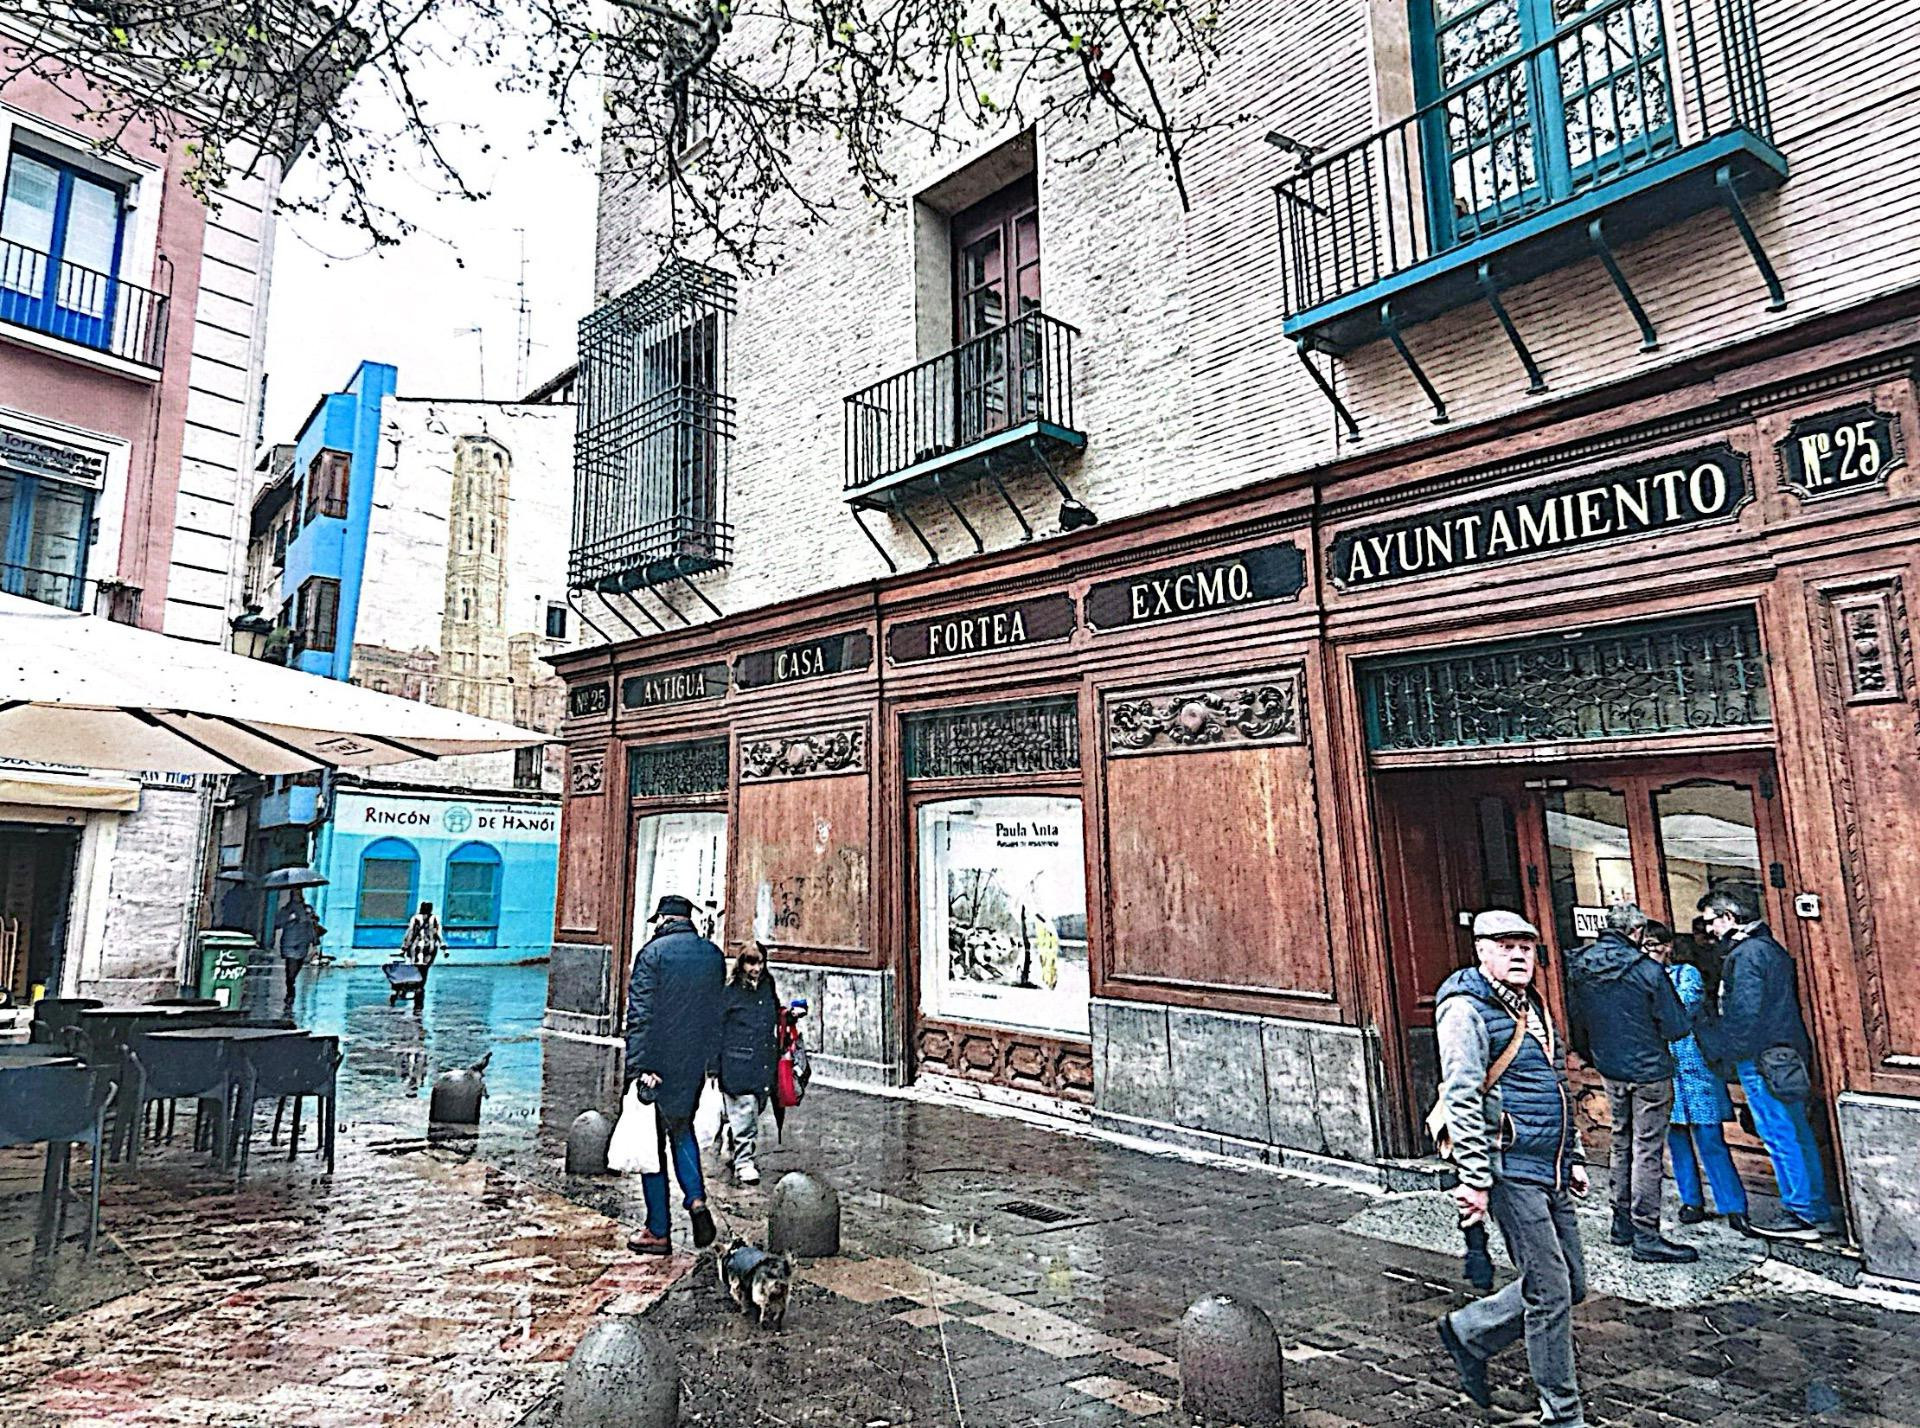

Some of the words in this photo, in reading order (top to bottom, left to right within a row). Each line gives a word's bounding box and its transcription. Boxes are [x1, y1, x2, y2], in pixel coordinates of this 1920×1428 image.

[1834, 420, 1880, 481] 25
[1347, 462, 1727, 583] AYUNTAMIENTO
[1131, 564, 1253, 619] EXCMO.
[928, 610, 1027, 655] FORTEA
[777, 646, 825, 680] CASA
[590, 688, 606, 711] 25
[644, 672, 705, 703] ANTIGUA
[365, 806, 430, 825] RINCÓN
[478, 816, 497, 829] DE
[995, 822, 1027, 837] Paula
